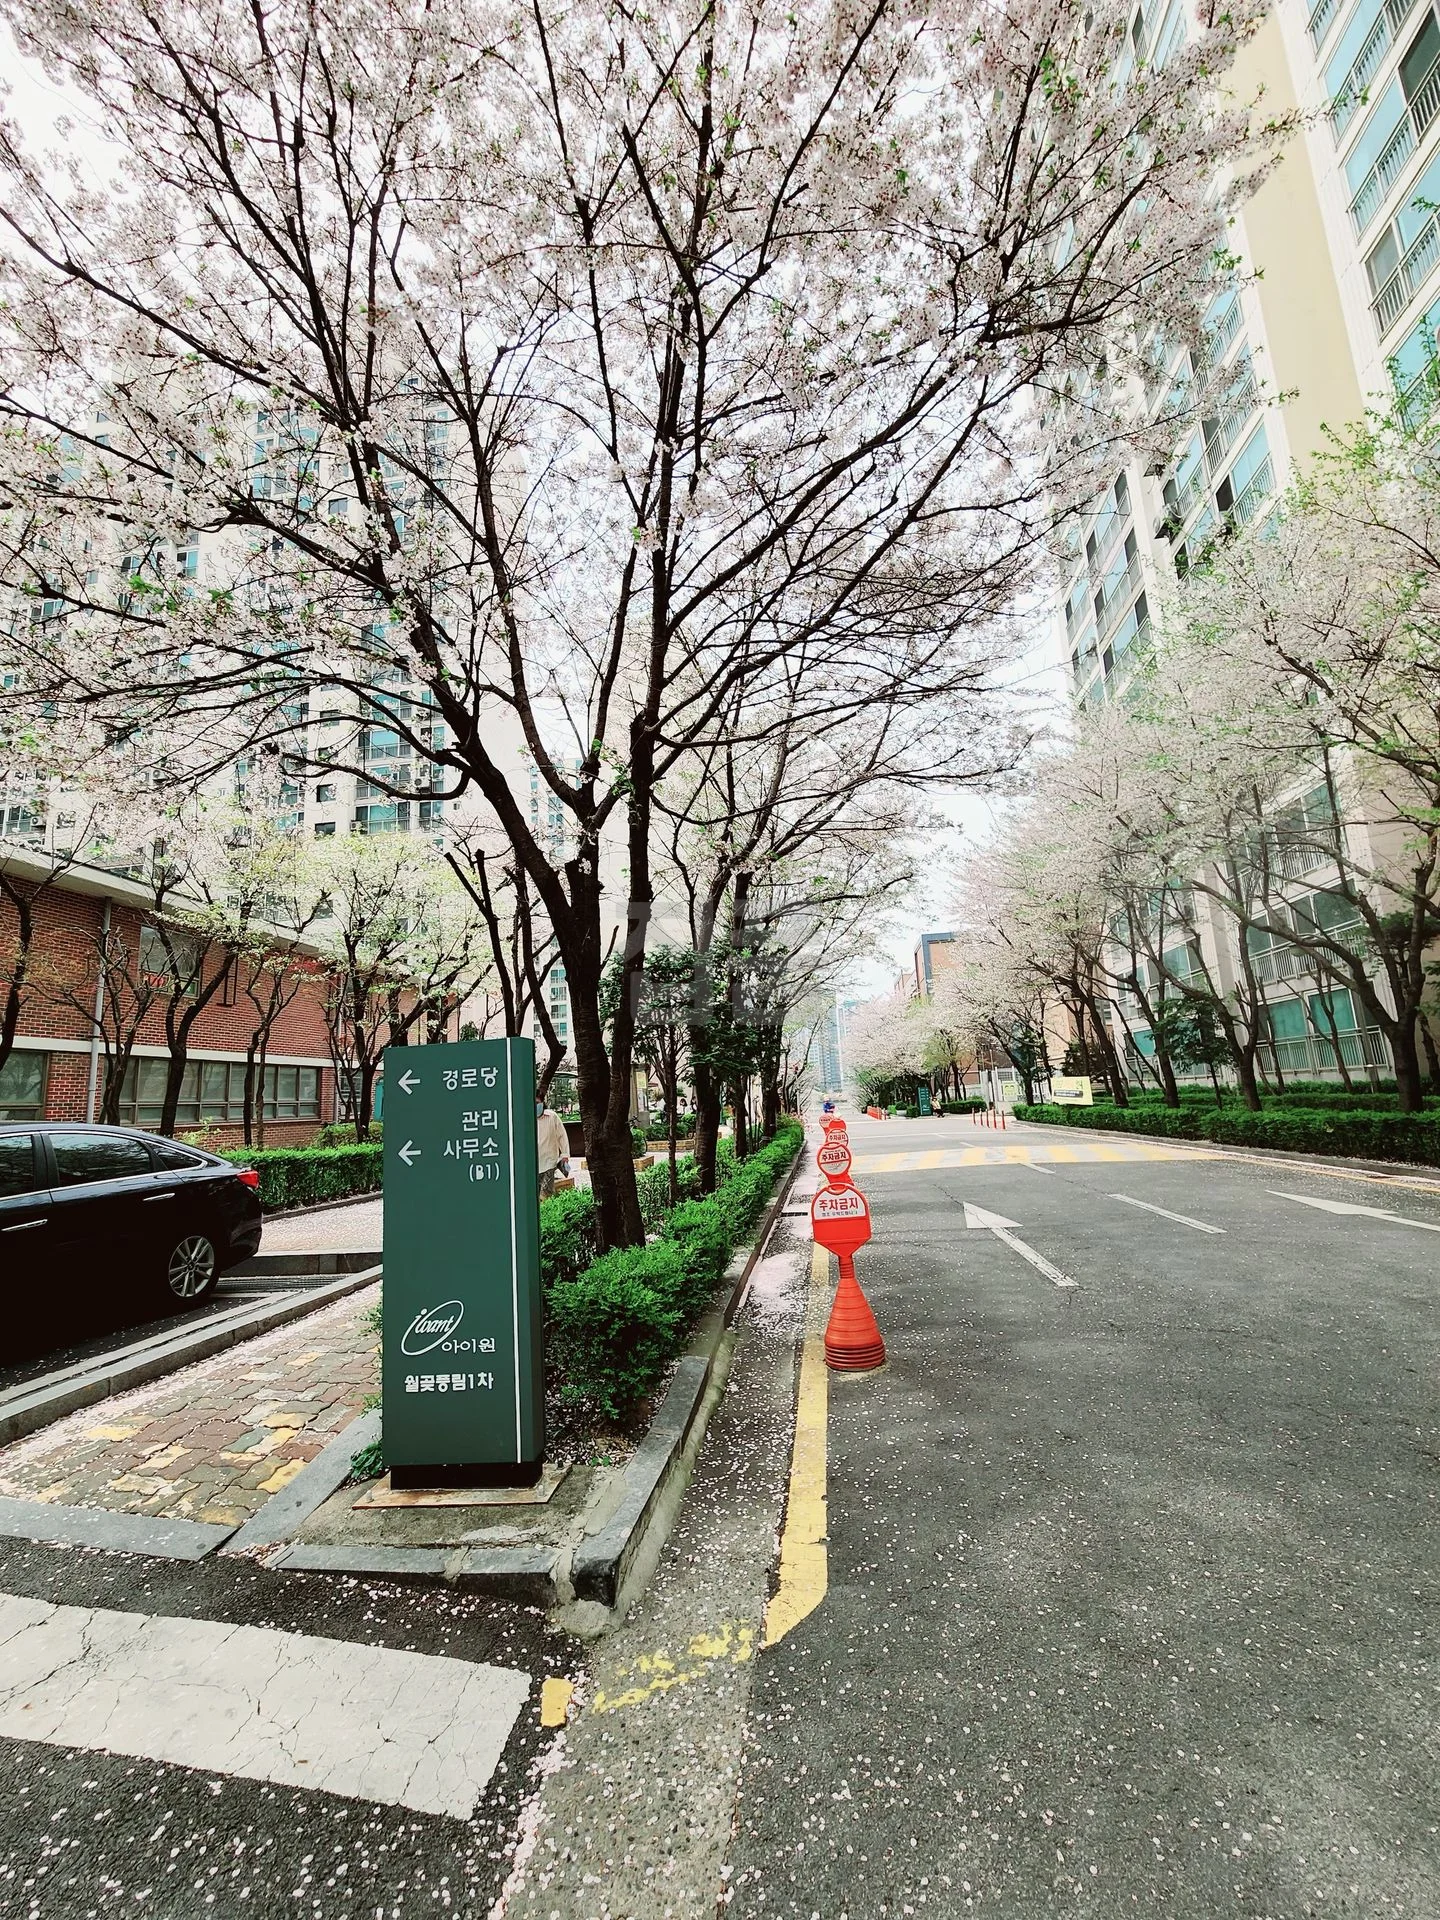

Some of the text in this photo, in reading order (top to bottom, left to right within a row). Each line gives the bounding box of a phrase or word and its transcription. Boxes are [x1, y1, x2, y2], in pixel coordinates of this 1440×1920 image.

[442, 1067, 499, 1090] 경로당
[462, 1110, 498, 1131] 관리
[443, 1137, 499, 1160] 사무소
[469, 1163, 500, 1182] (B1)
[819, 1197, 859, 1212] 주차금지
[441, 1337, 496, 1354] 아이원
[404, 1372, 494, 1393] 월곶풍림1차
